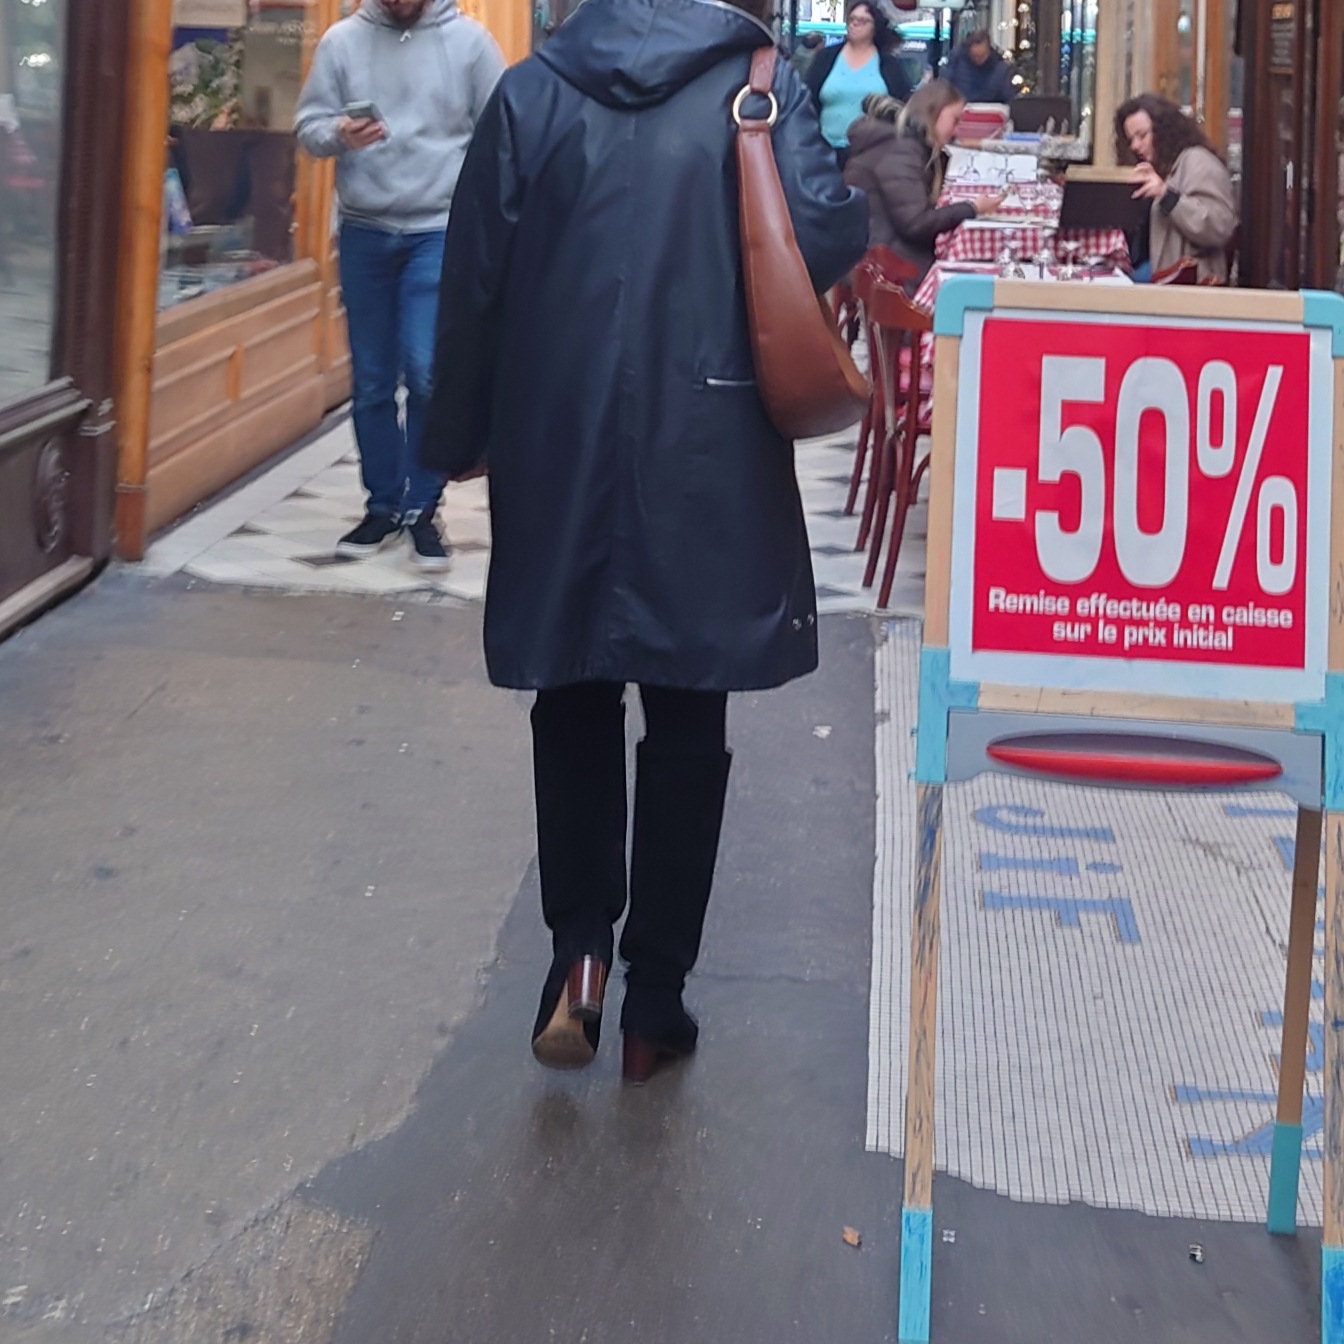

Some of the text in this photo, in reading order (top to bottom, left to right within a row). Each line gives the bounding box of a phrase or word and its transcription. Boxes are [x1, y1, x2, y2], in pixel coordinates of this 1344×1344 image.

[992, 354, 1298, 595] -50%
[988, 586, 1293, 629] Remise effectuée en caisse
[1052, 618, 1233, 651] sur le prix initial
